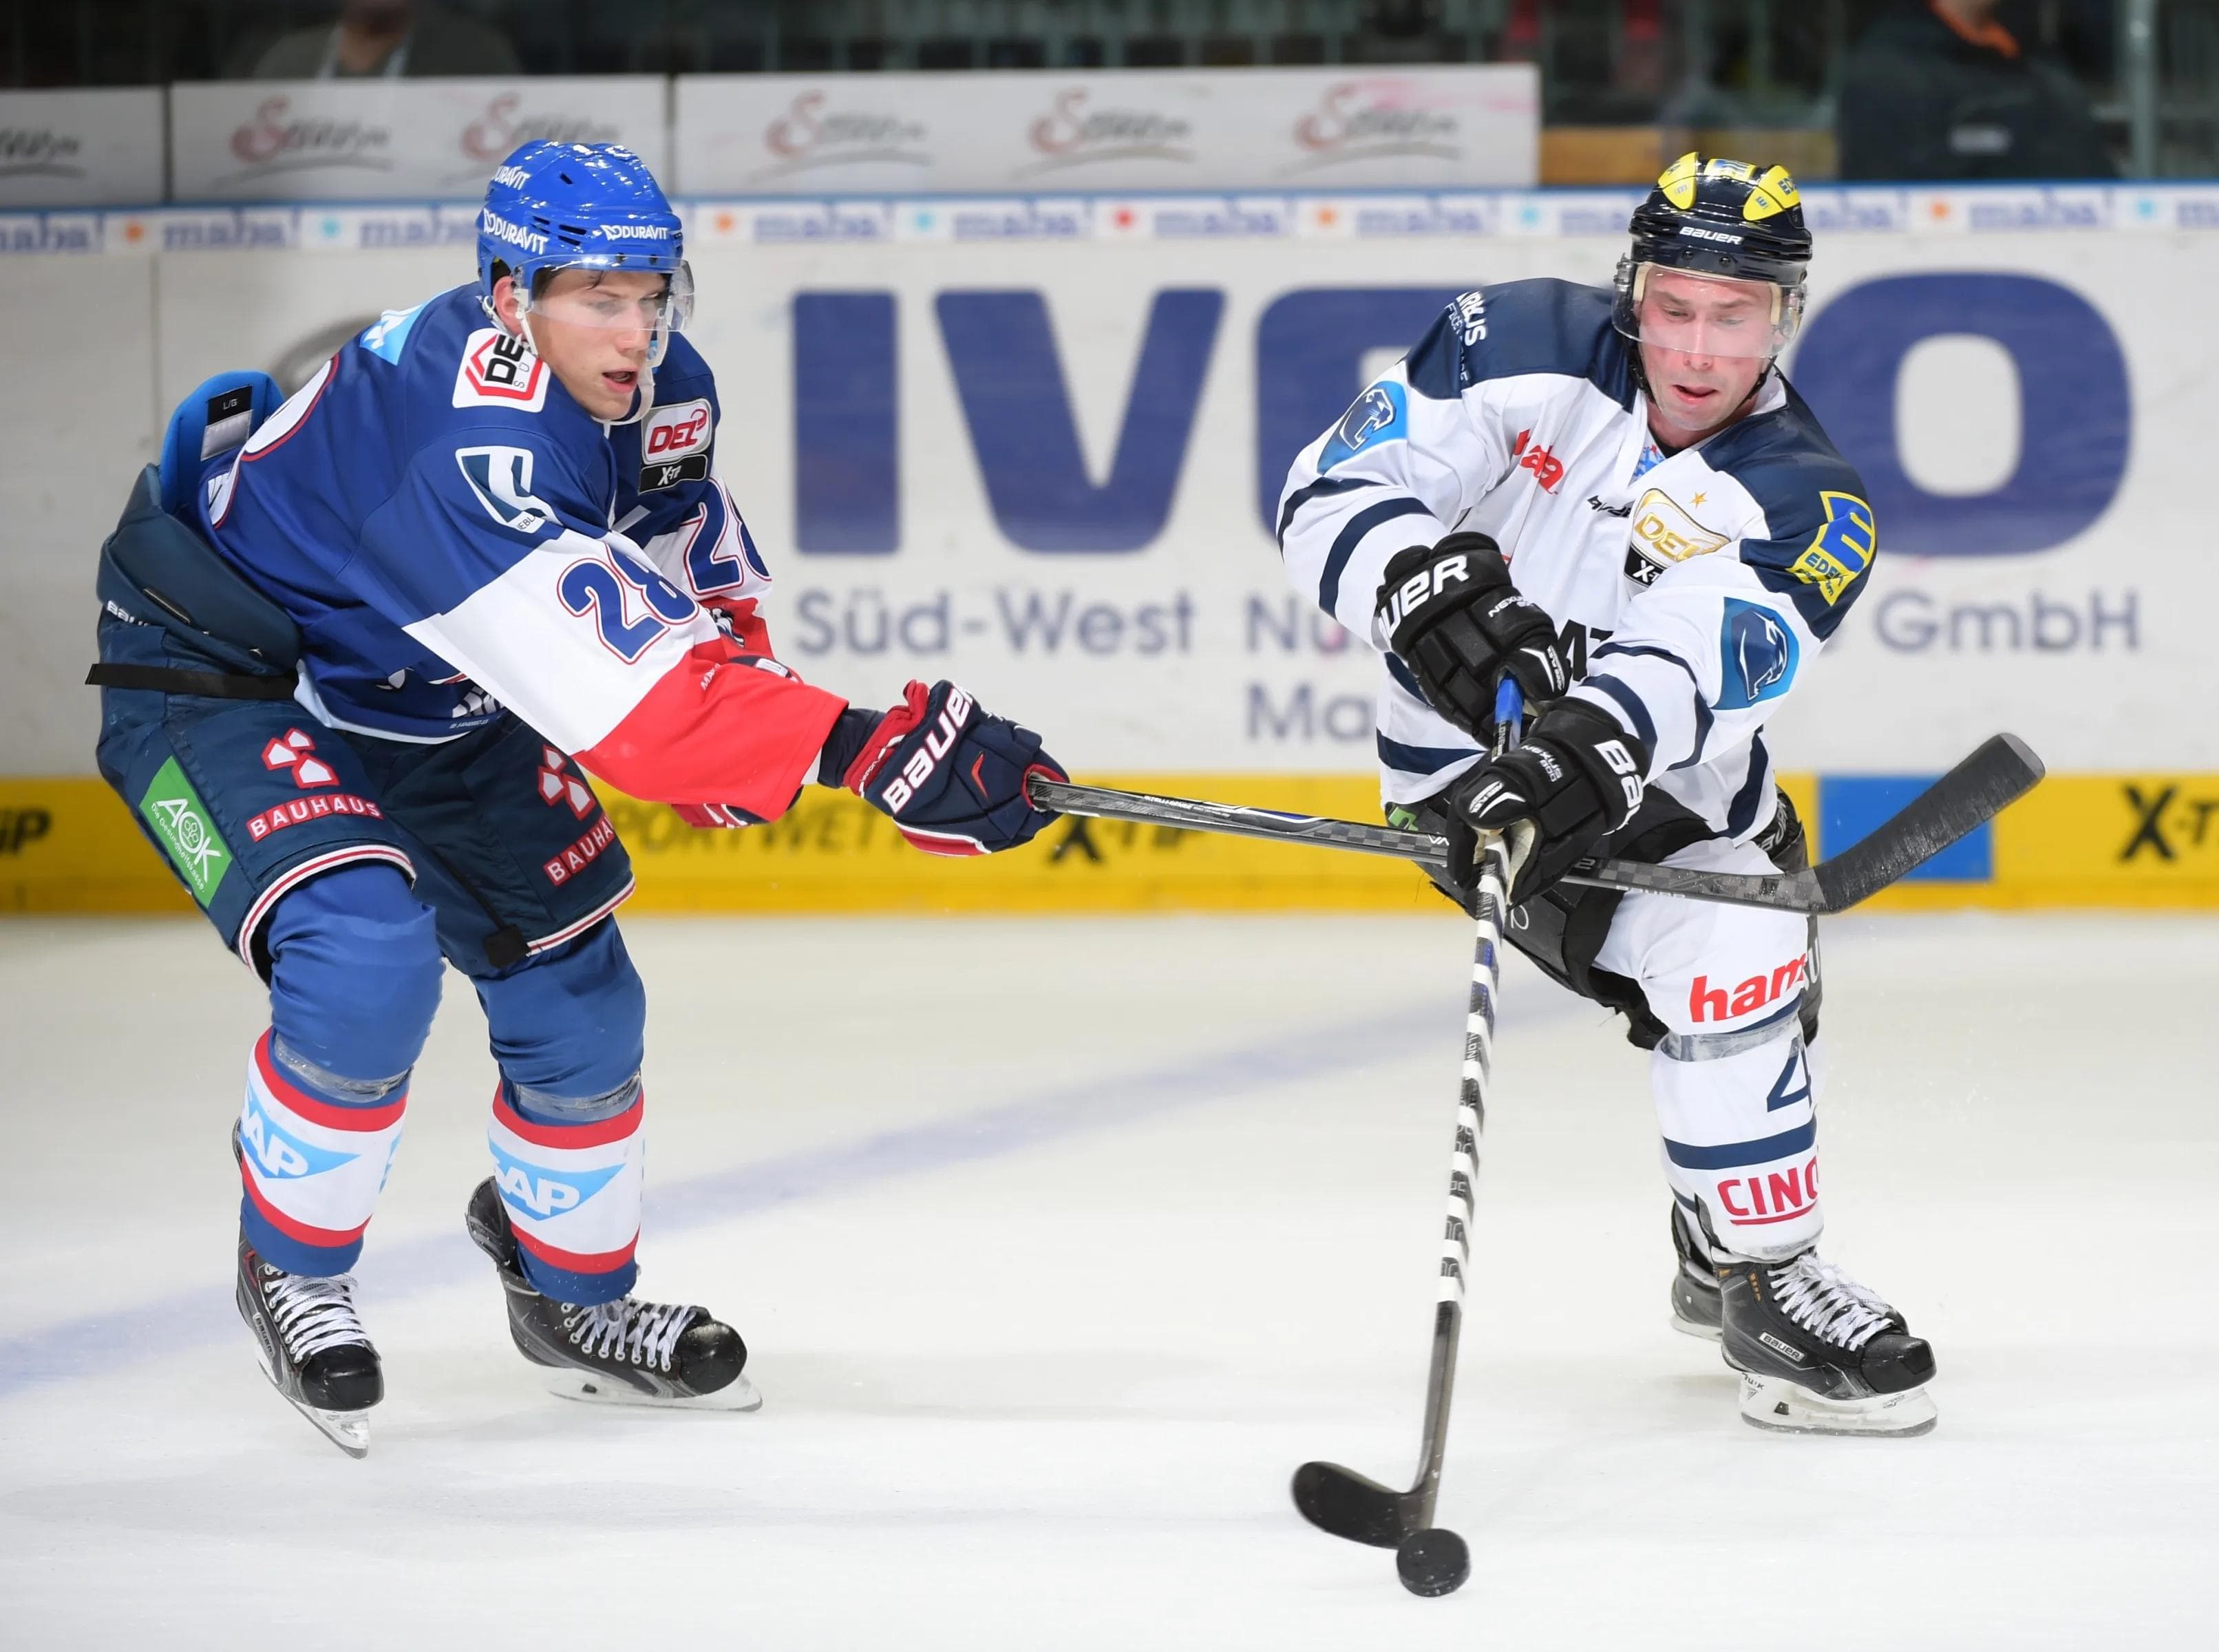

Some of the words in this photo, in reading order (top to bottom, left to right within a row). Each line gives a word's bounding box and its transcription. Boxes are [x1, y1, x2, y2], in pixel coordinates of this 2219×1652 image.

[494, 217, 549, 255] DURAVIT
[622, 224, 669, 240] DURAVIT
[1679, 226, 1745, 245] BAUER
[484, 334, 524, 385] DE
[648, 420, 698, 454] DEL
[557, 540, 700, 666] 28
[795, 587, 1196, 657] Süd-West
[1378, 554, 1471, 639] UER
[1873, 587, 2141, 656] GmbH
[155, 798, 222, 883] AOK
[250, 796, 381, 838] BAUHAUS
[548, 816, 614, 882] BAUHA
[1763, 1335, 1802, 1360] BAUER
